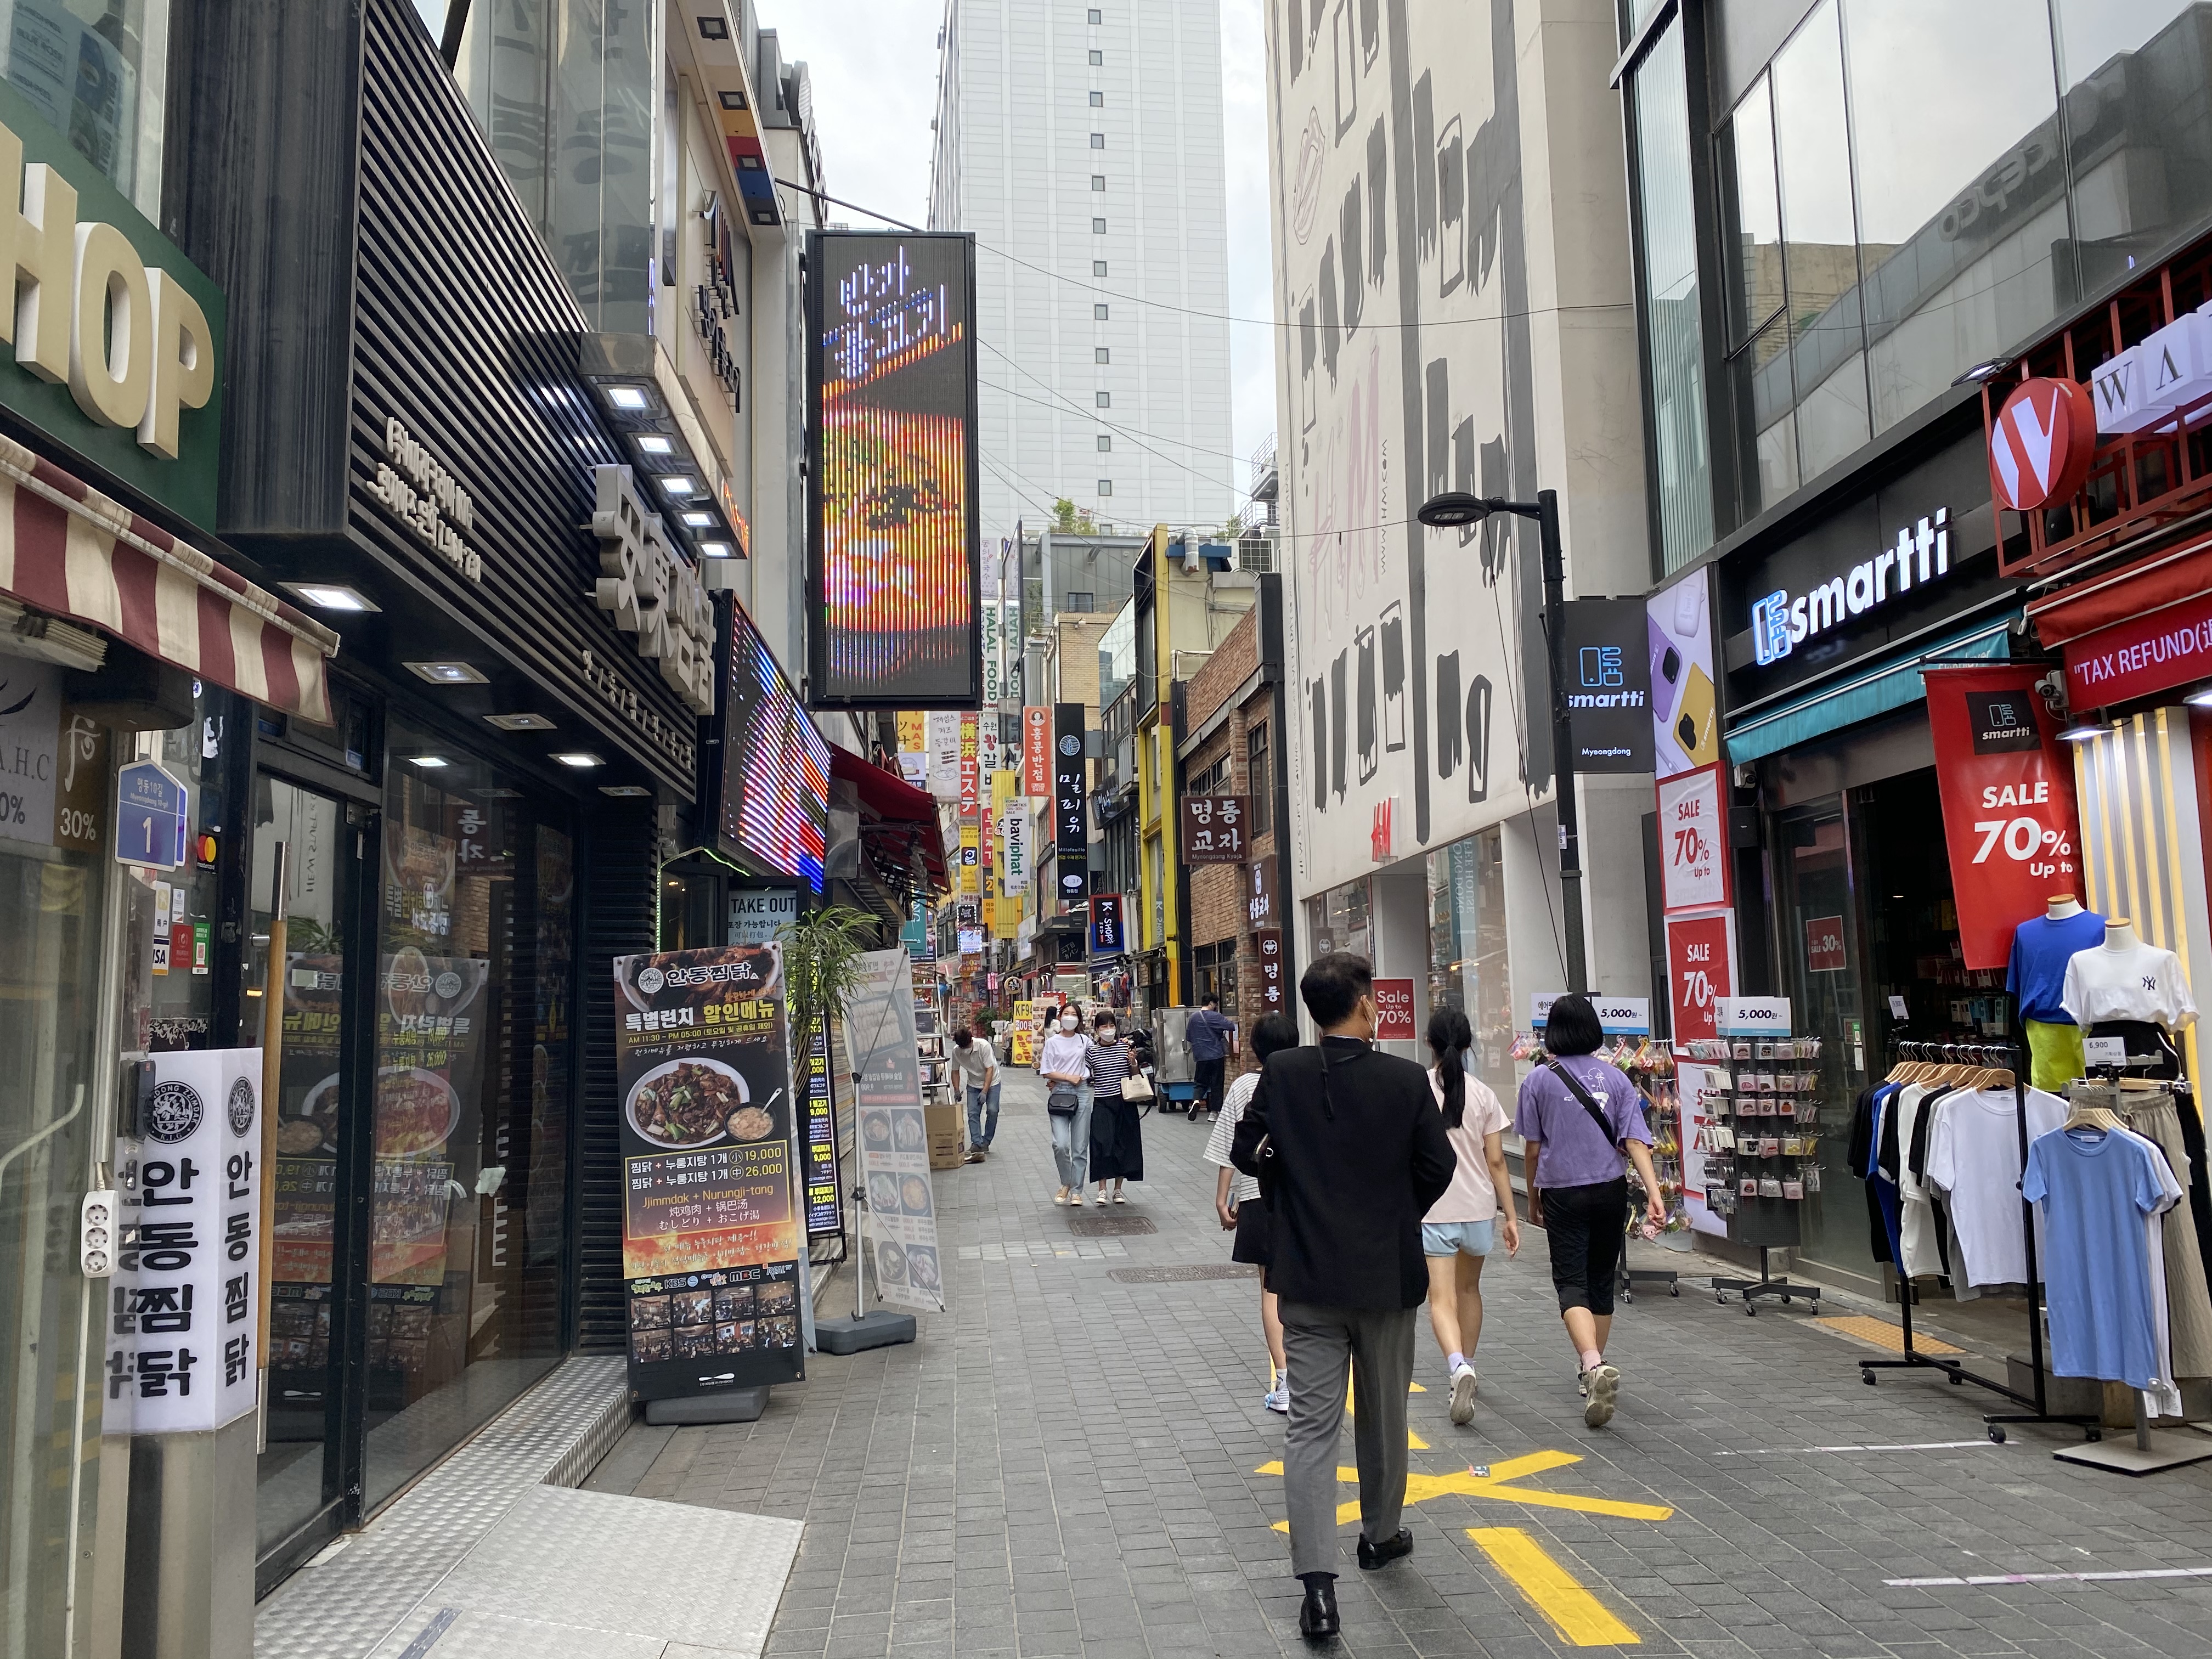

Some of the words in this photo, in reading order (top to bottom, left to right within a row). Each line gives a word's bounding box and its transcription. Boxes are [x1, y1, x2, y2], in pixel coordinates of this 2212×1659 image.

[1791, 506, 1951, 645] smartti
[986, 607, 996, 653] HALAL
[987, 660, 997, 701] FOOD
[983, 723, 997, 731] 수원
[1982, 727, 2030, 742] smartti
[1030, 727, 1045, 781] 홍콩반점
[1581, 746, 1632, 758] Myeongdong
[137, 777, 163, 797] 명동10길
[1982, 782, 2049, 809] SALE
[1059, 774, 1082, 833] 밀피유
[1190, 799, 1241, 824] 명동
[1678, 799, 1701, 820] SALE
[59, 808, 96, 841] 30%
[143, 817, 152, 853] 1
[1009, 819, 1023, 875] baviphat
[1191, 828, 1242, 853] 교자
[1674, 830, 1710, 867] 70%
[1972, 817, 2071, 864] 70%
[1226, 852, 1243, 860] Kyoja
[1694, 866, 1703, 879] Up
[1704, 865, 1710, 876] to
[2030, 861, 2055, 879] Up
[2060, 861, 2073, 873] to
[731, 898, 765, 913] TAKE
[770, 898, 795, 912] OUT
[728, 921, 742, 929] 포장
[744, 919, 781, 928] 가능합니다
[1688, 943, 1710, 962] SALE
[1822, 935, 1842, 952] 30%
[153, 950, 166, 964] ISA
[666, 961, 753, 987] 안동찜닭
[1264, 962, 1280, 1012] 명동
[1377, 990, 1409, 1004] Sale
[1683, 972, 1718, 1009] 70%
[625, 1006, 695, 1032] 특별런치
[703, 1000, 775, 1025] 할인메뉴
[1378, 1011, 1411, 1024] 70%
[1703, 1010, 1713, 1025] Up
[628, 1036, 640, 1044] AM
[641, 1034, 660, 1043] 11:30
[668, 1031, 679, 1040] PM
[680, 1029, 702, 1039] 05:00
[631, 1161, 652, 1175] 찜닭
[665, 1154, 707, 1171] 누룽지탕
[710, 1152, 727, 1165] 1개
[744, 1147, 782, 1161] 19,000
[814, 1153, 831, 1163] 9,000
[631, 1177, 652, 1190] 찜닭
[666, 1170, 708, 1187] 누룽지탕
[711, 1168, 729, 1181] 1개
[745, 1163, 783, 1178] 26,000
[703, 1185, 774, 1202] Nurungji-tang
[812, 1195, 834, 1204] 12,000
[669, 1203, 701, 1217] 炖鸡肉
[716, 1199, 748, 1212] 锅巴汤
[659, 1216, 700, 1231] むしどり
[718, 1210, 760, 1224] おこげ湯
[137, 1157, 199, 1397] 안동찜닭
[224, 1150, 252, 1387] 안동찜닭
[664, 1278, 686, 1289] KBS
